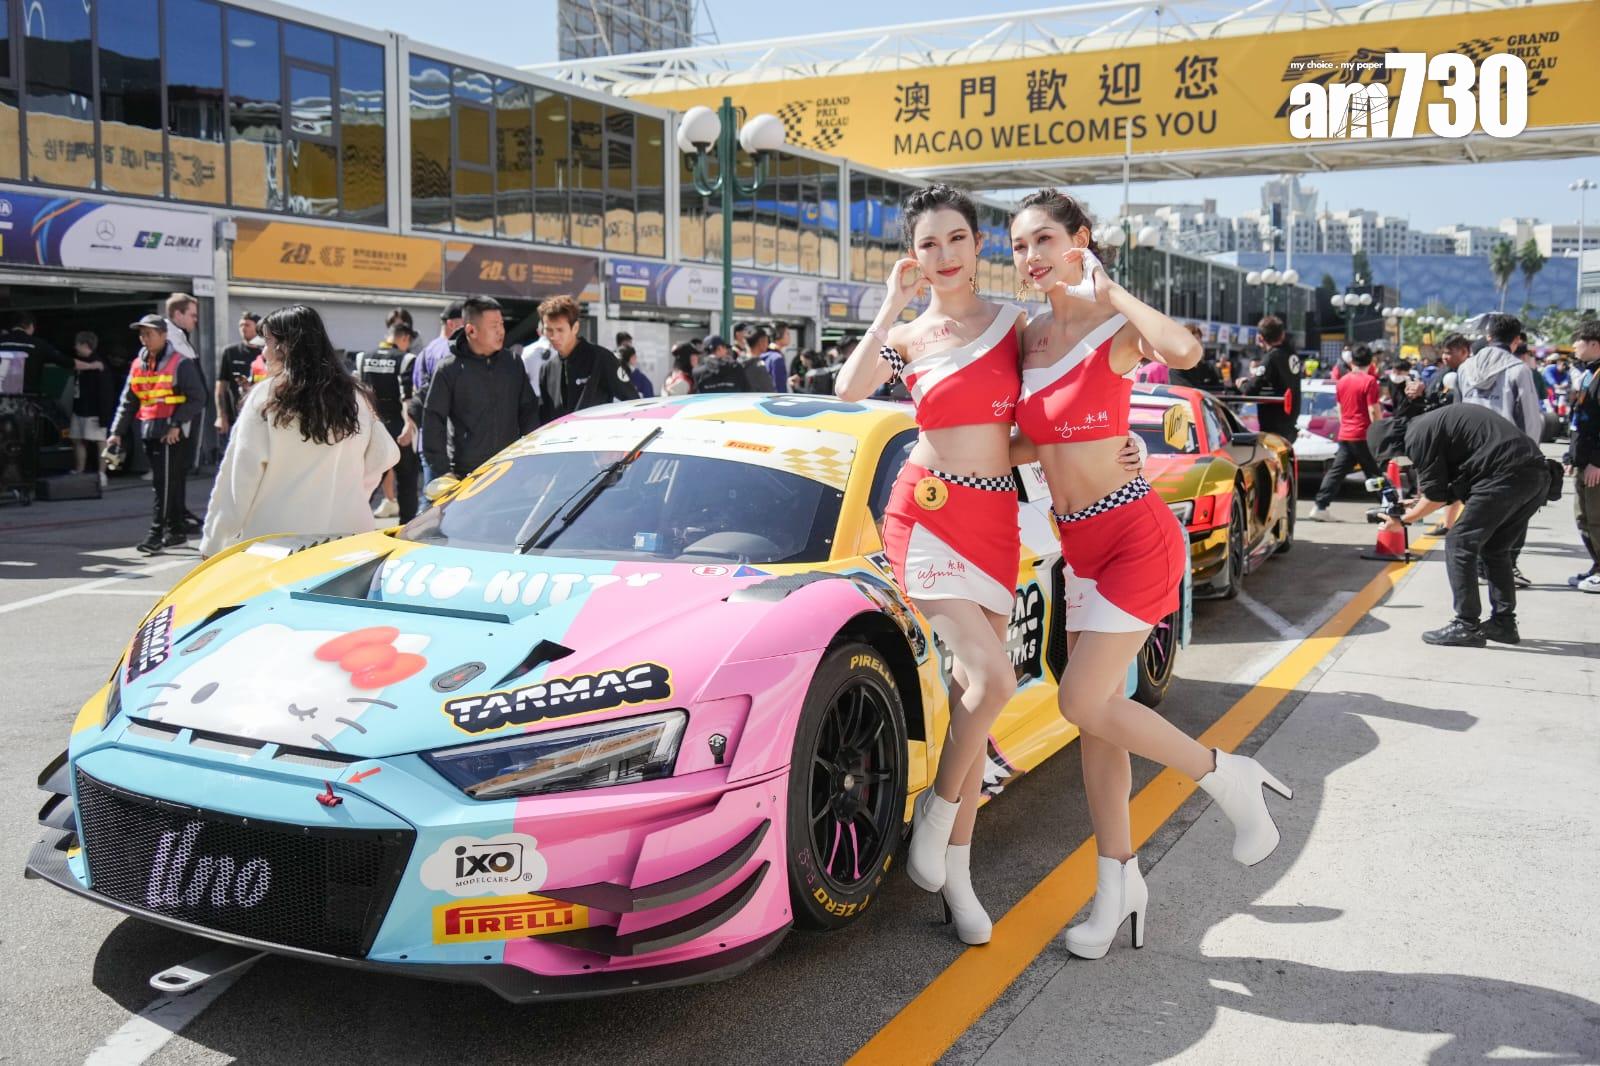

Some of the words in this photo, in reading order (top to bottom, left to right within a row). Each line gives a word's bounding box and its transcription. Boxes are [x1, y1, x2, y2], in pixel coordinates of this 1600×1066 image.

[1507, 32, 1559, 46] GRAND
[1526, 57, 1558, 69] CAU
[894, 54, 1219, 123] 澳門歡迎您
[816, 96, 850, 107] GRAND
[816, 108, 837, 118] PRIX
[816, 117, 849, 128] MACAU
[894, 128, 983, 156] MACAO
[991, 115, 1147, 149] WELCOMES
[1156, 110, 1217, 137] YOU
[926, 486, 937, 502] 3
[849, 654, 896, 689] PIRELLI
[450, 666, 653, 723] TARMAC
[455, 876, 511, 888] MODELCARS
[812, 887, 858, 917] ZERO
[445, 899, 575, 936] PIRELLI
